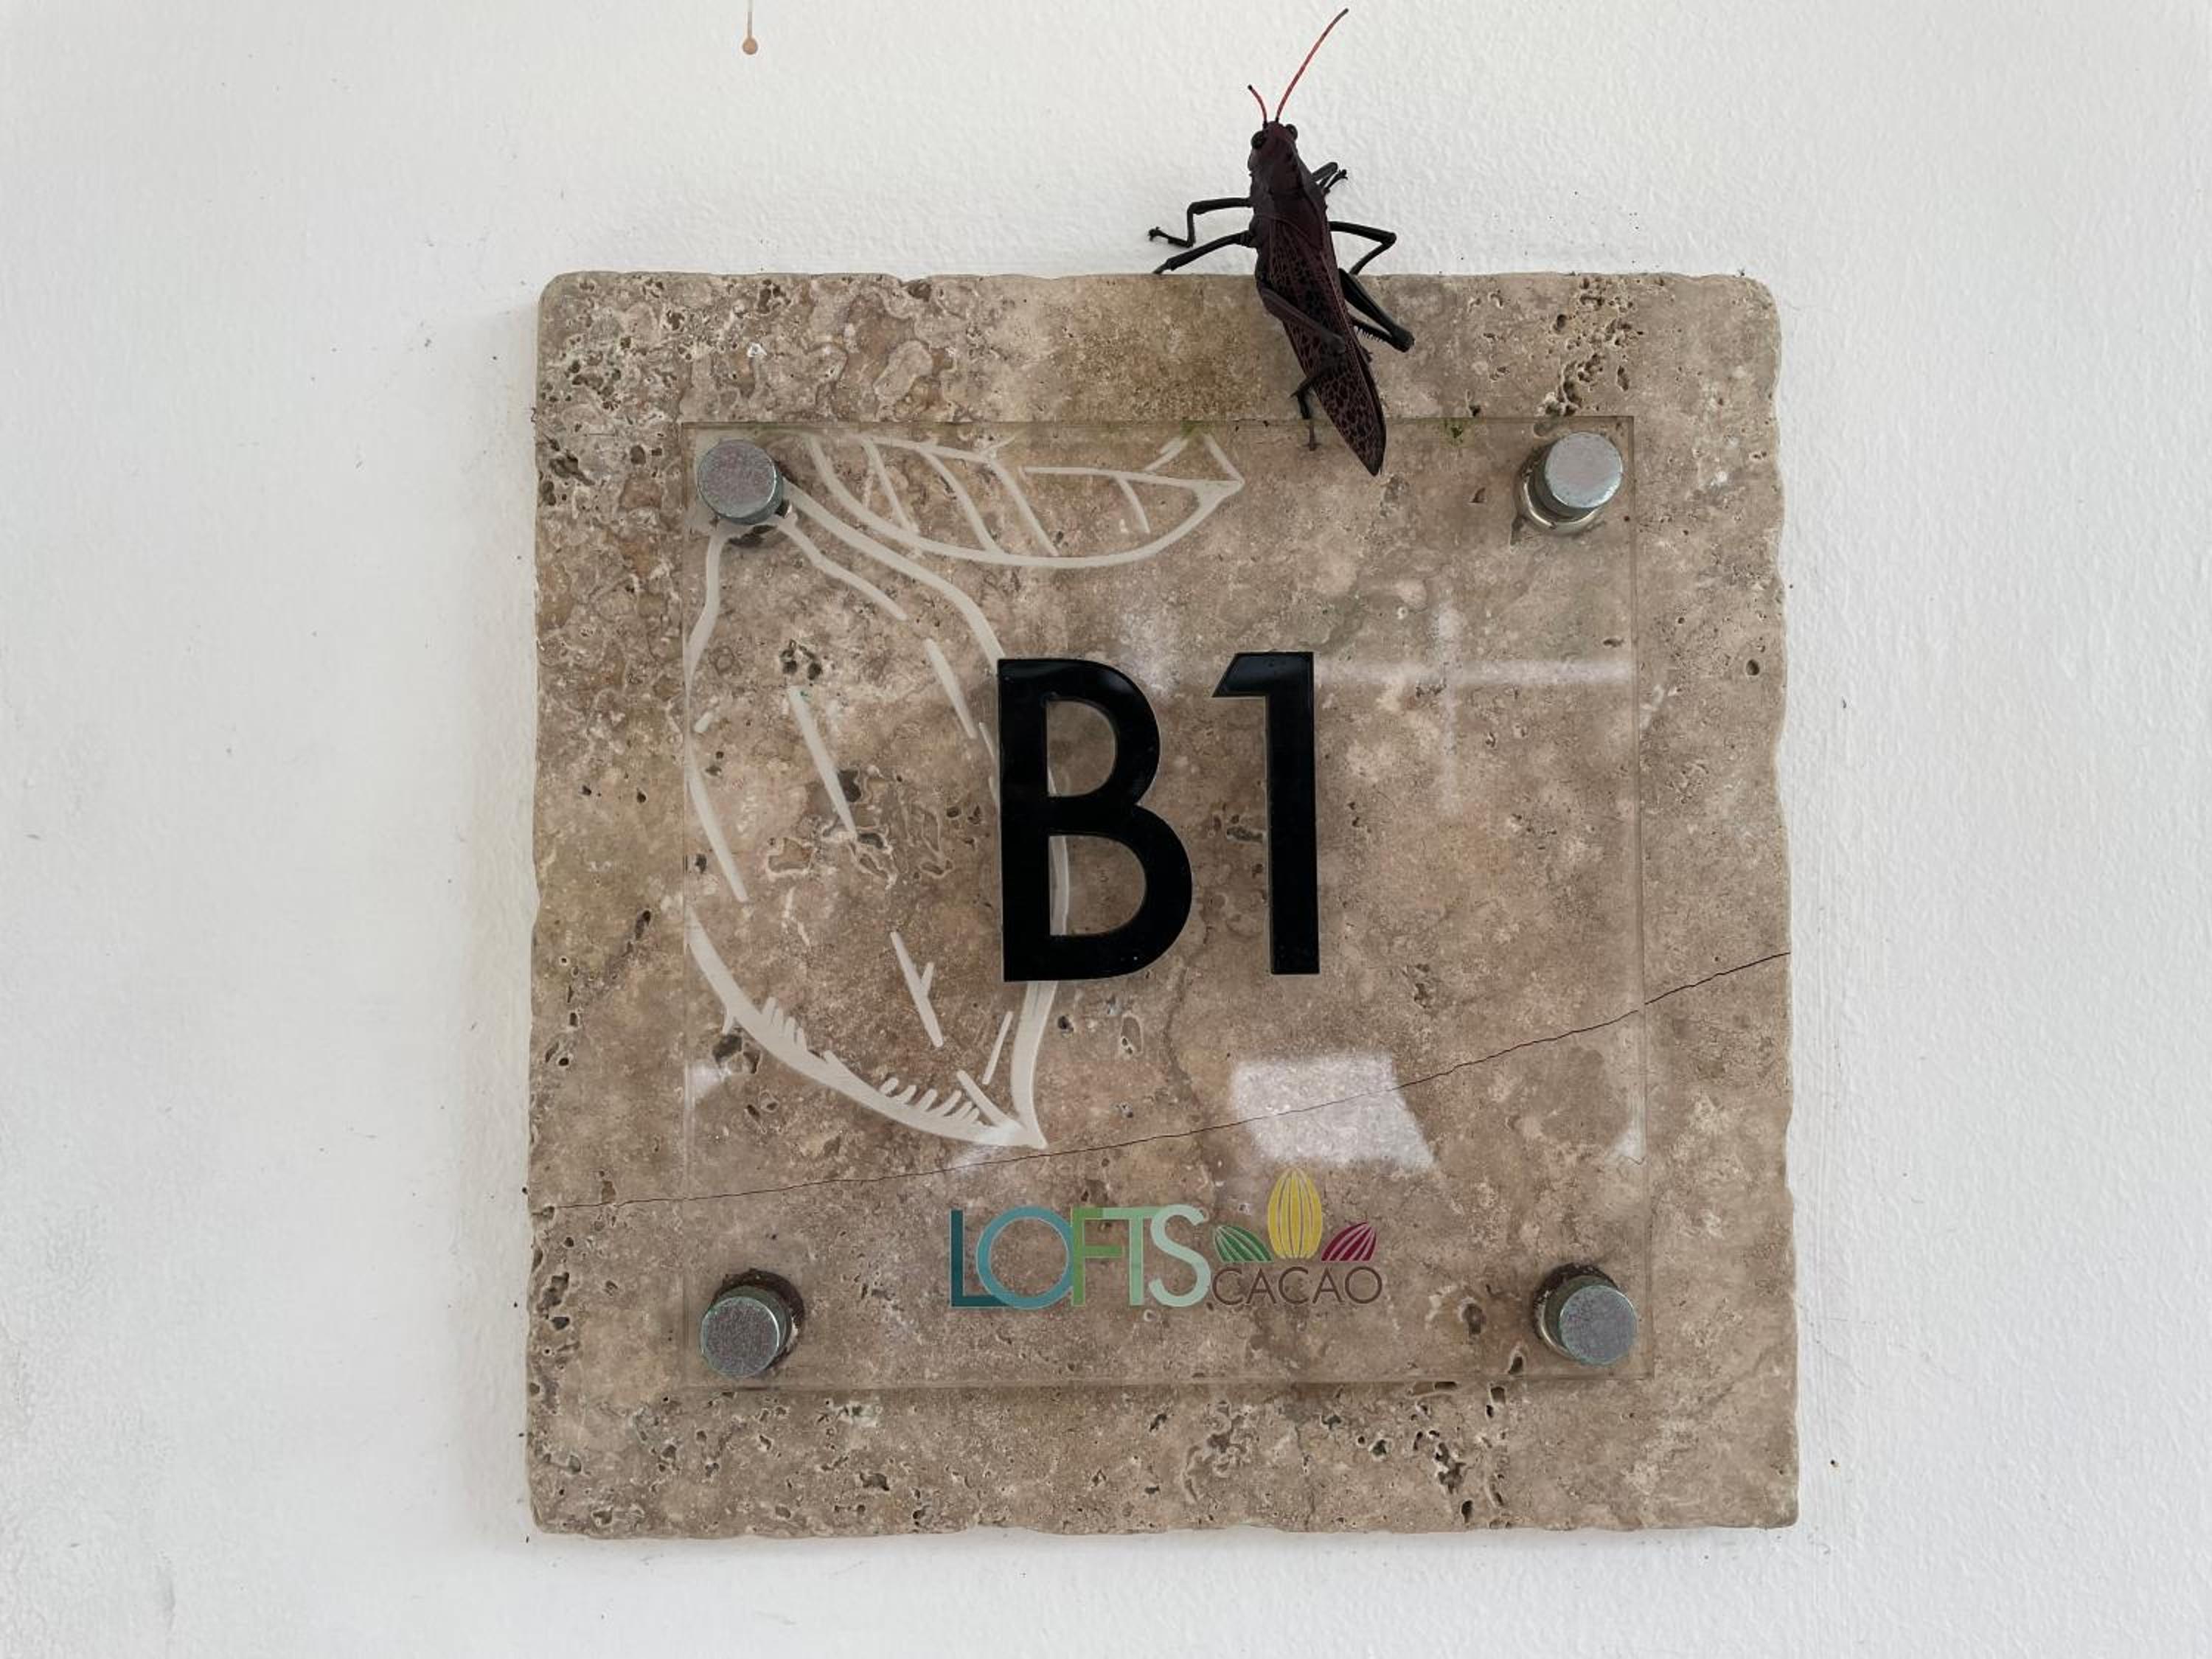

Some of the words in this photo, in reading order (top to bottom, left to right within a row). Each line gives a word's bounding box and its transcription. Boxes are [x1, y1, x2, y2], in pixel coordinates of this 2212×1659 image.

[998, 651, 1320, 981] B1
[950, 1204, 1211, 1310] LOFTS
[1211, 1266, 1383, 1305] CACAO
